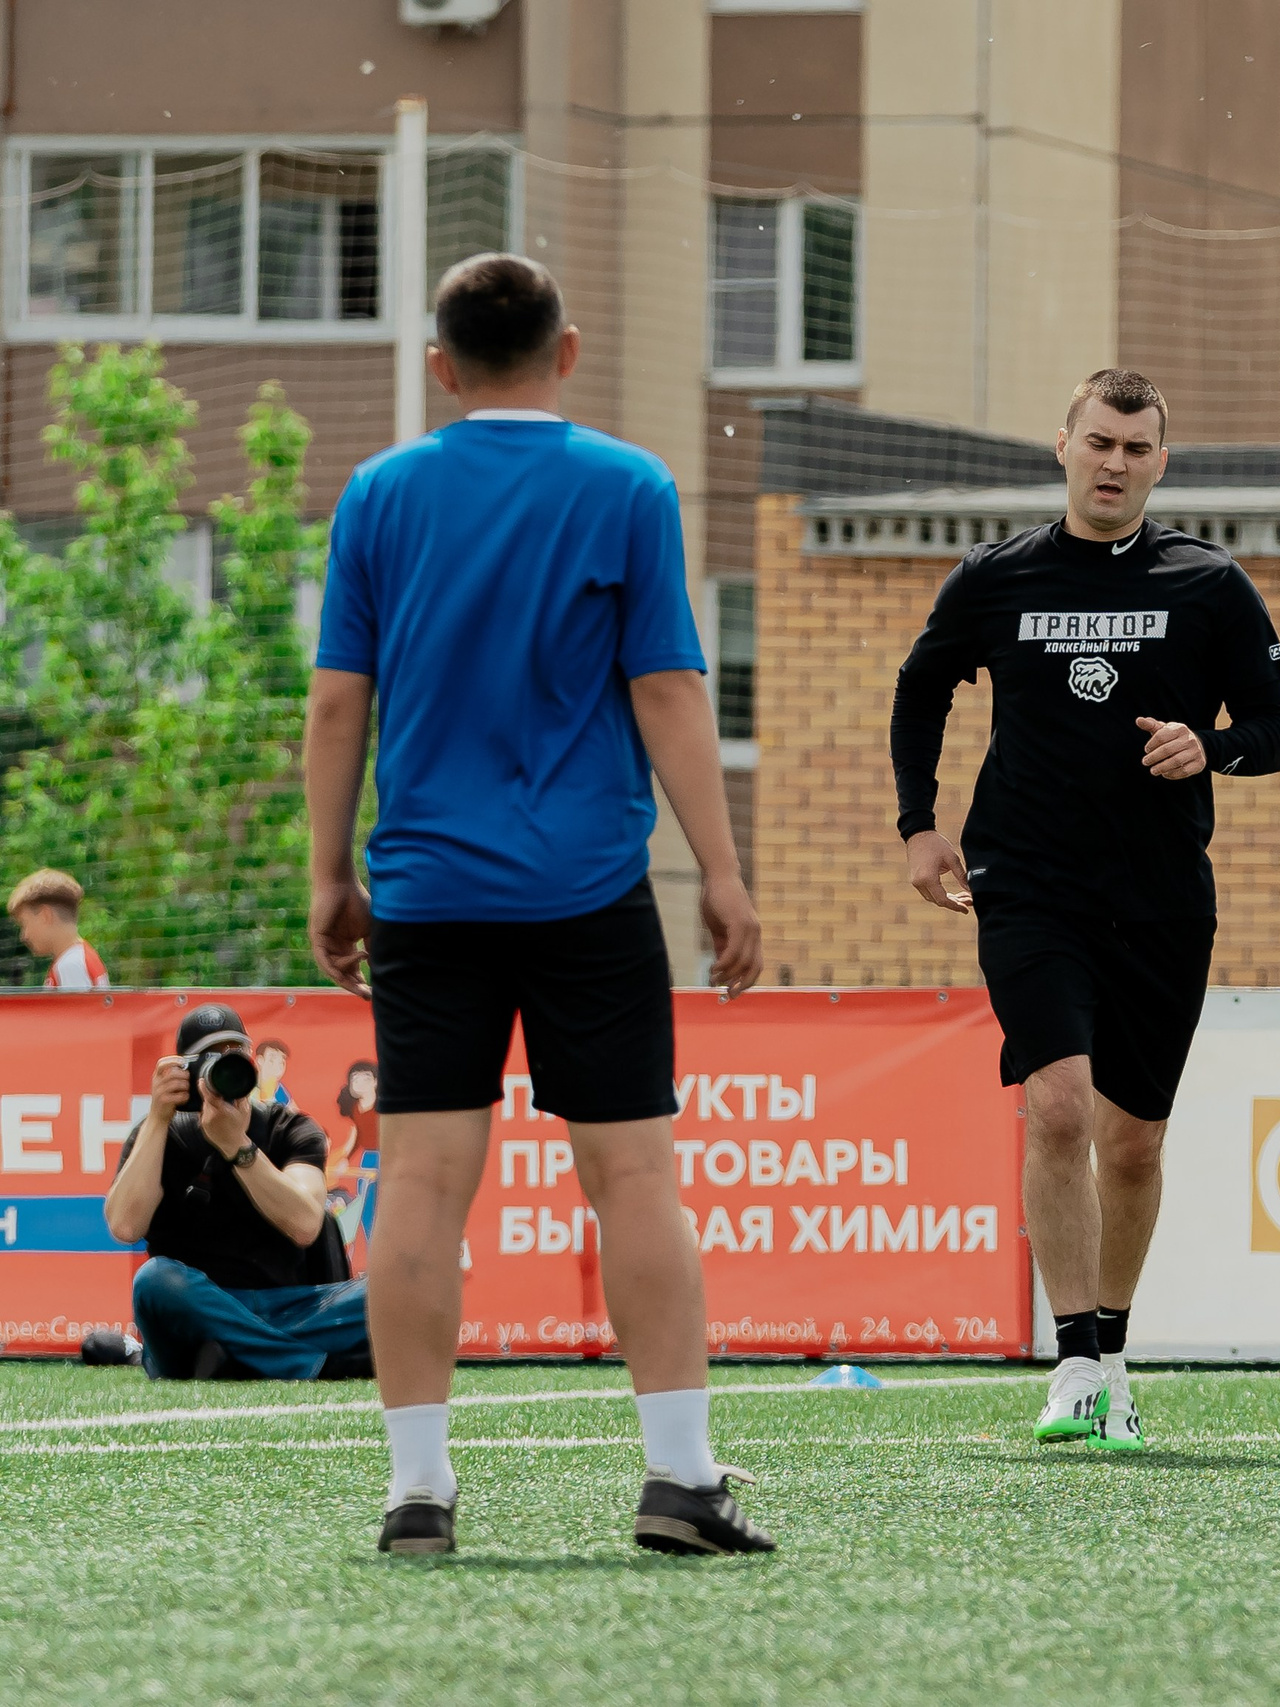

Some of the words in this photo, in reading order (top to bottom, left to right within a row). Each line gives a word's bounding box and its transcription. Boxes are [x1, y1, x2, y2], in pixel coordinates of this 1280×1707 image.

[1030, 614, 1157, 638] ТРАКТОР
[1044, 640, 1110, 653] ХОККЕЙНЫЙ
[1111, 641, 1141, 653] КЛУБ
[502, 1074, 816, 1121] ПУКТЫ
[501, 1138, 909, 1187] ПРТОВАРЫ
[500, 1205, 774, 1255] БЫАЯ
[788, 1204, 999, 1253] ХИМИЯ
